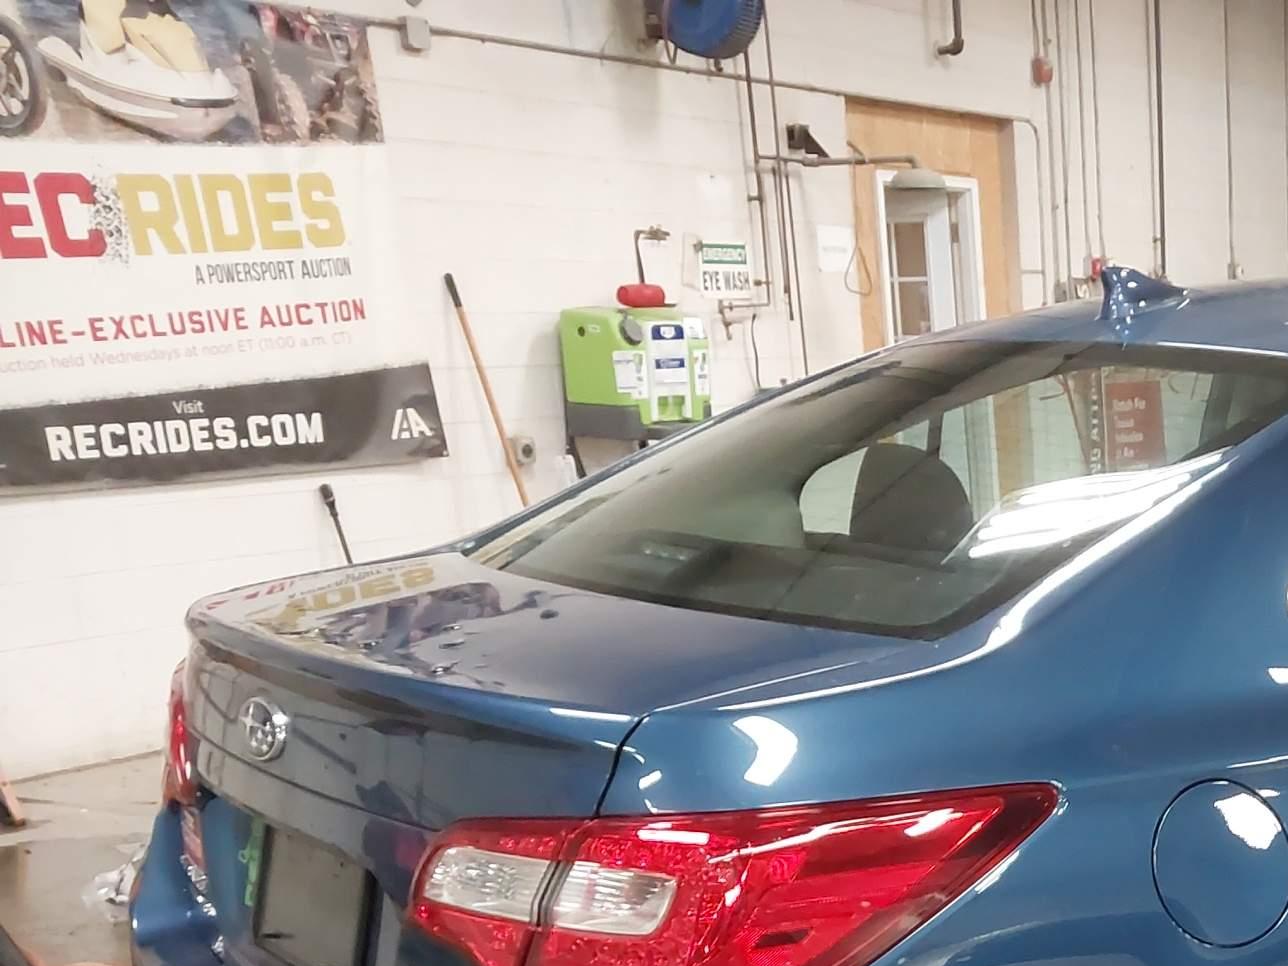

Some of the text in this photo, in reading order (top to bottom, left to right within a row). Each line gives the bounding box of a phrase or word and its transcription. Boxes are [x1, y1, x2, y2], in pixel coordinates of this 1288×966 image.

[116, 171, 347, 257] RIDES
[195, 256, 352, 285] A POWERSPORT AUCTION
[702, 271, 752, 291] EYE WASH
[260, 298, 367, 329] AUCTION
[51, 352, 85, 369] held
[89, 347, 181, 366] Wednesdays
[184, 346, 198, 358] at
[202, 343, 233, 356] noon
[238, 339, 255, 352] ET
[172, 400, 204, 416] Visit
[45, 412, 325, 462] RECRIDES.COM
